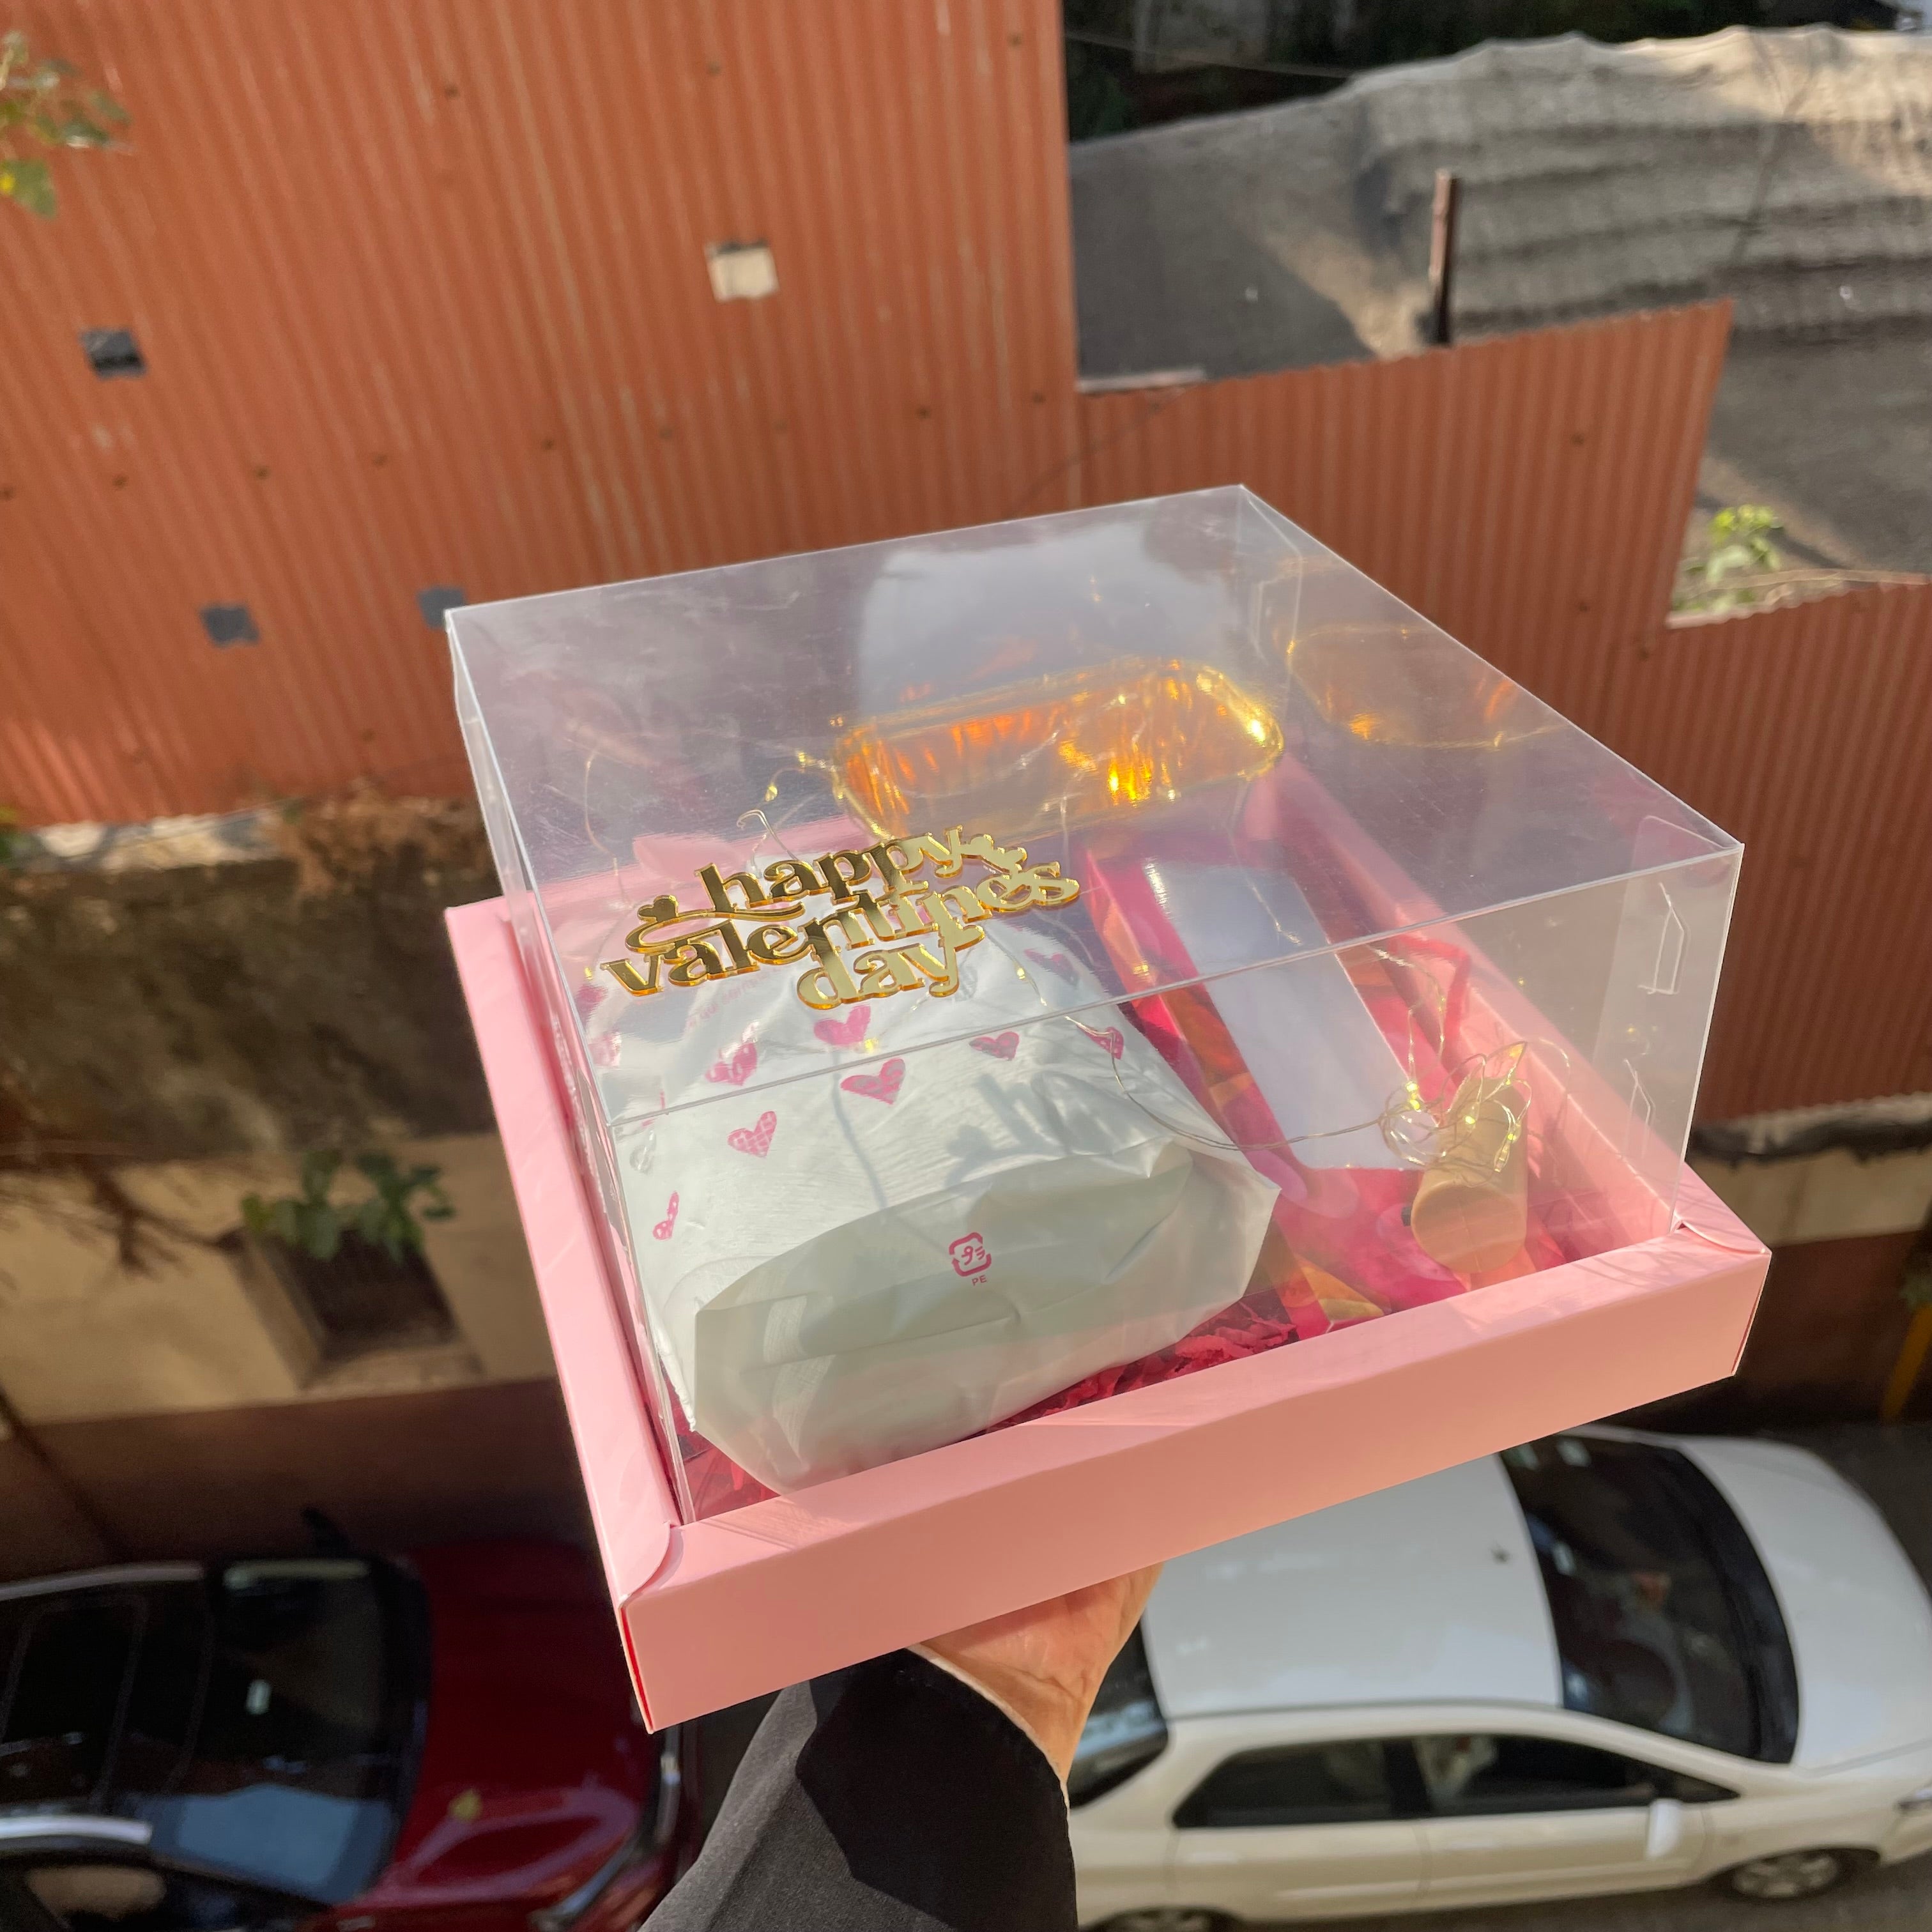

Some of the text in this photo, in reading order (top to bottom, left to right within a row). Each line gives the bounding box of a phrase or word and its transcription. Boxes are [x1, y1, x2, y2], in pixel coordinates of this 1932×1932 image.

[694, 825, 963, 912] happy
[600, 861, 1081, 997] valentines
[797, 940, 962, 1009] day
[972, 1275, 987, 1286] PE
